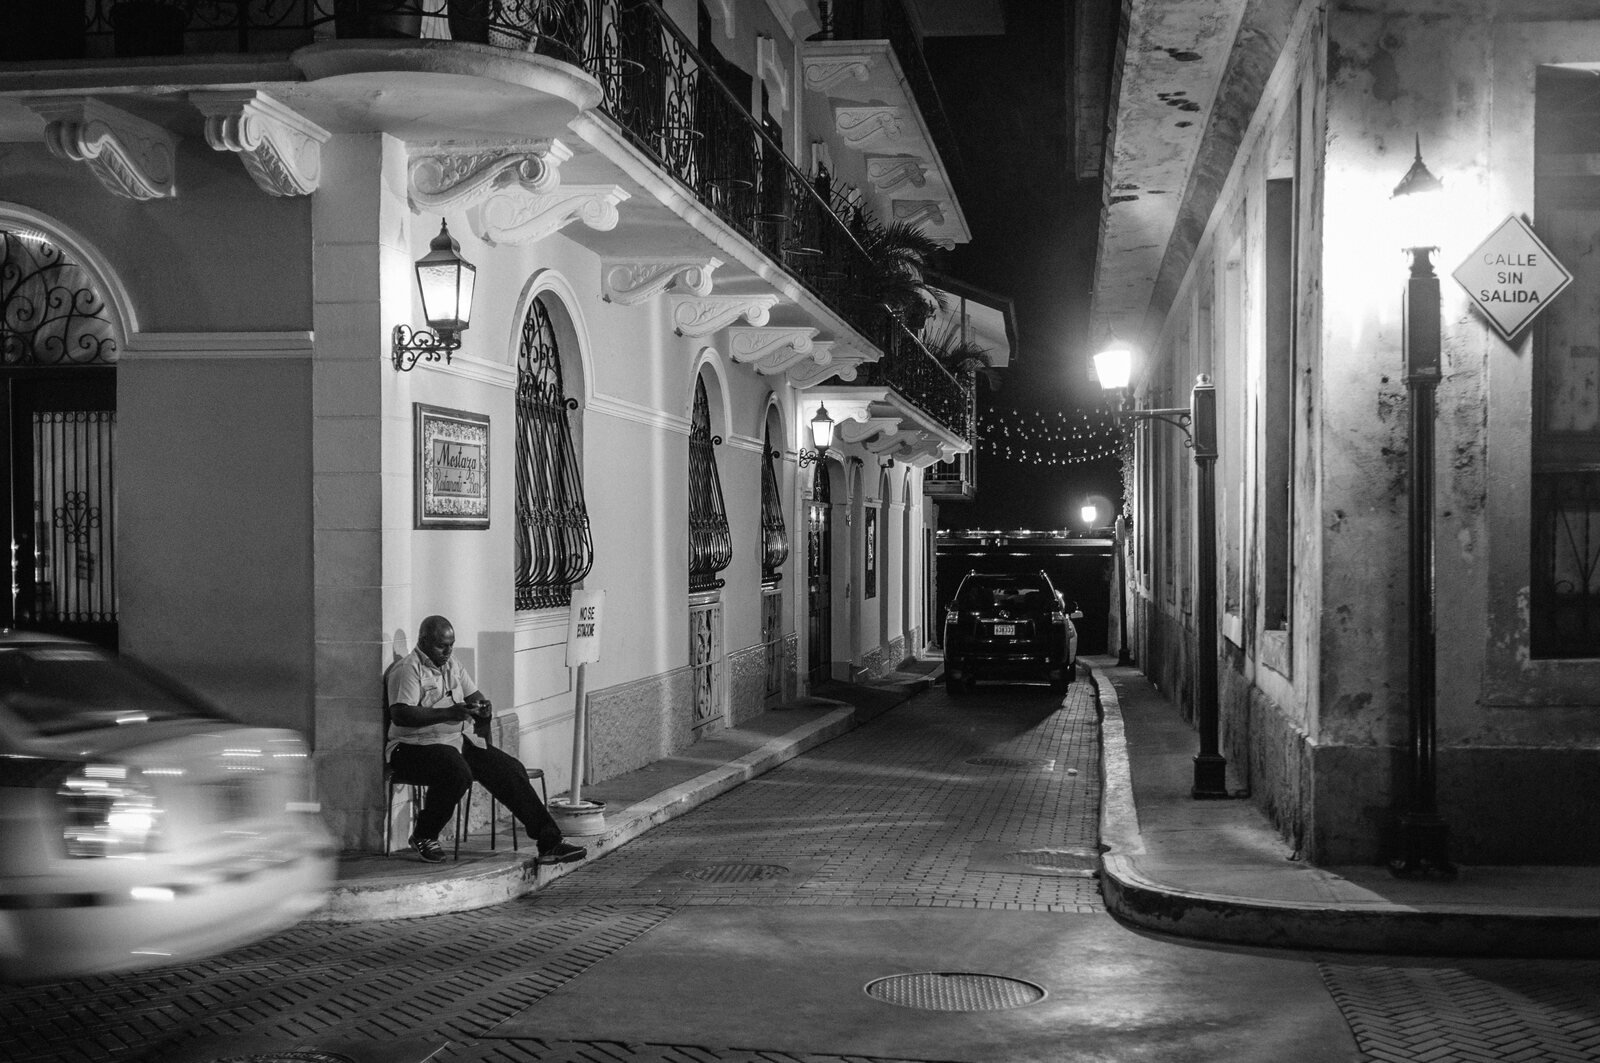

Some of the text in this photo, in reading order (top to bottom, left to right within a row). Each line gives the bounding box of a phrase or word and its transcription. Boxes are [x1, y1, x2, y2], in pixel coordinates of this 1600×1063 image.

[1483, 253, 1537, 267] CALLE
[1497, 271, 1523, 284] SIN
[1480, 289, 1540, 303] SALIDA
[579, 606, 595, 621] NO SE
